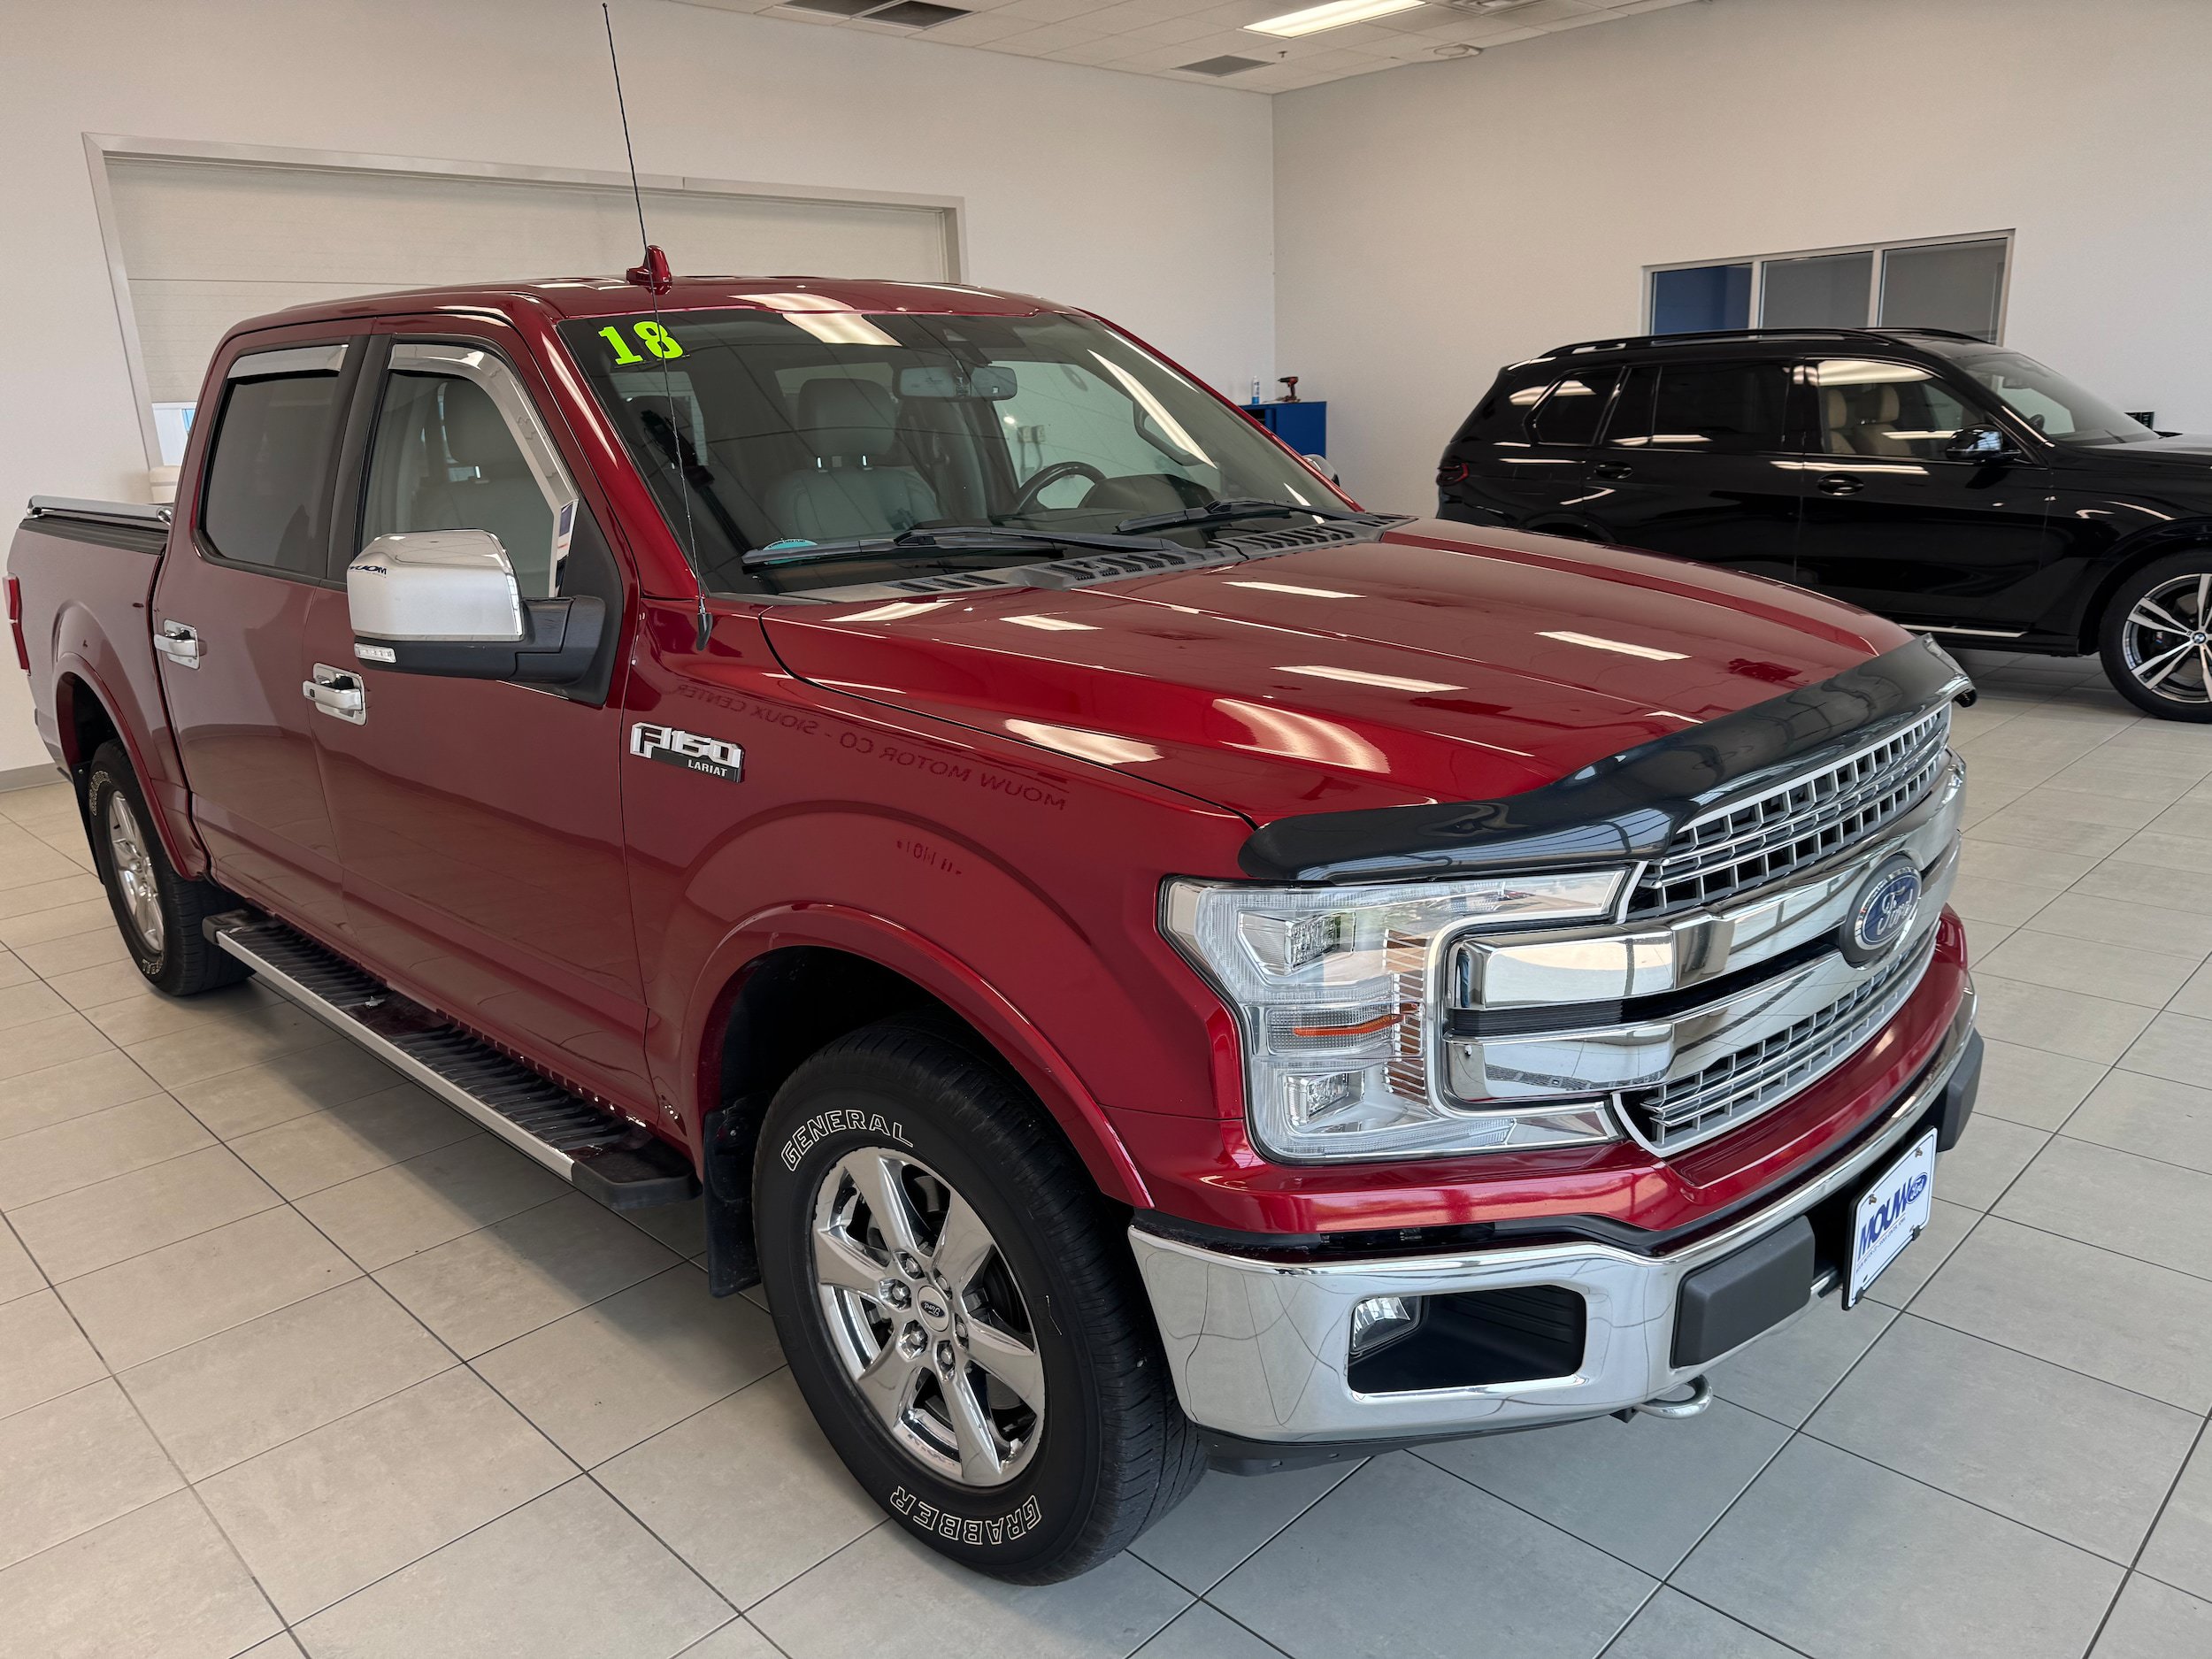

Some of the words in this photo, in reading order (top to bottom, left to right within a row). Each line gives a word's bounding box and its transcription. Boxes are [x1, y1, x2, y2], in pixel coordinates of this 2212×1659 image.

[597, 320, 684, 365] 18
[687, 759, 728, 778] LARIAT
[1876, 885, 1914, 936] Ford
[780, 1109, 914, 1172] GENERAL
[1857, 1175, 1913, 1262] MOUW
[889, 1485, 1042, 1546] GRABBER
